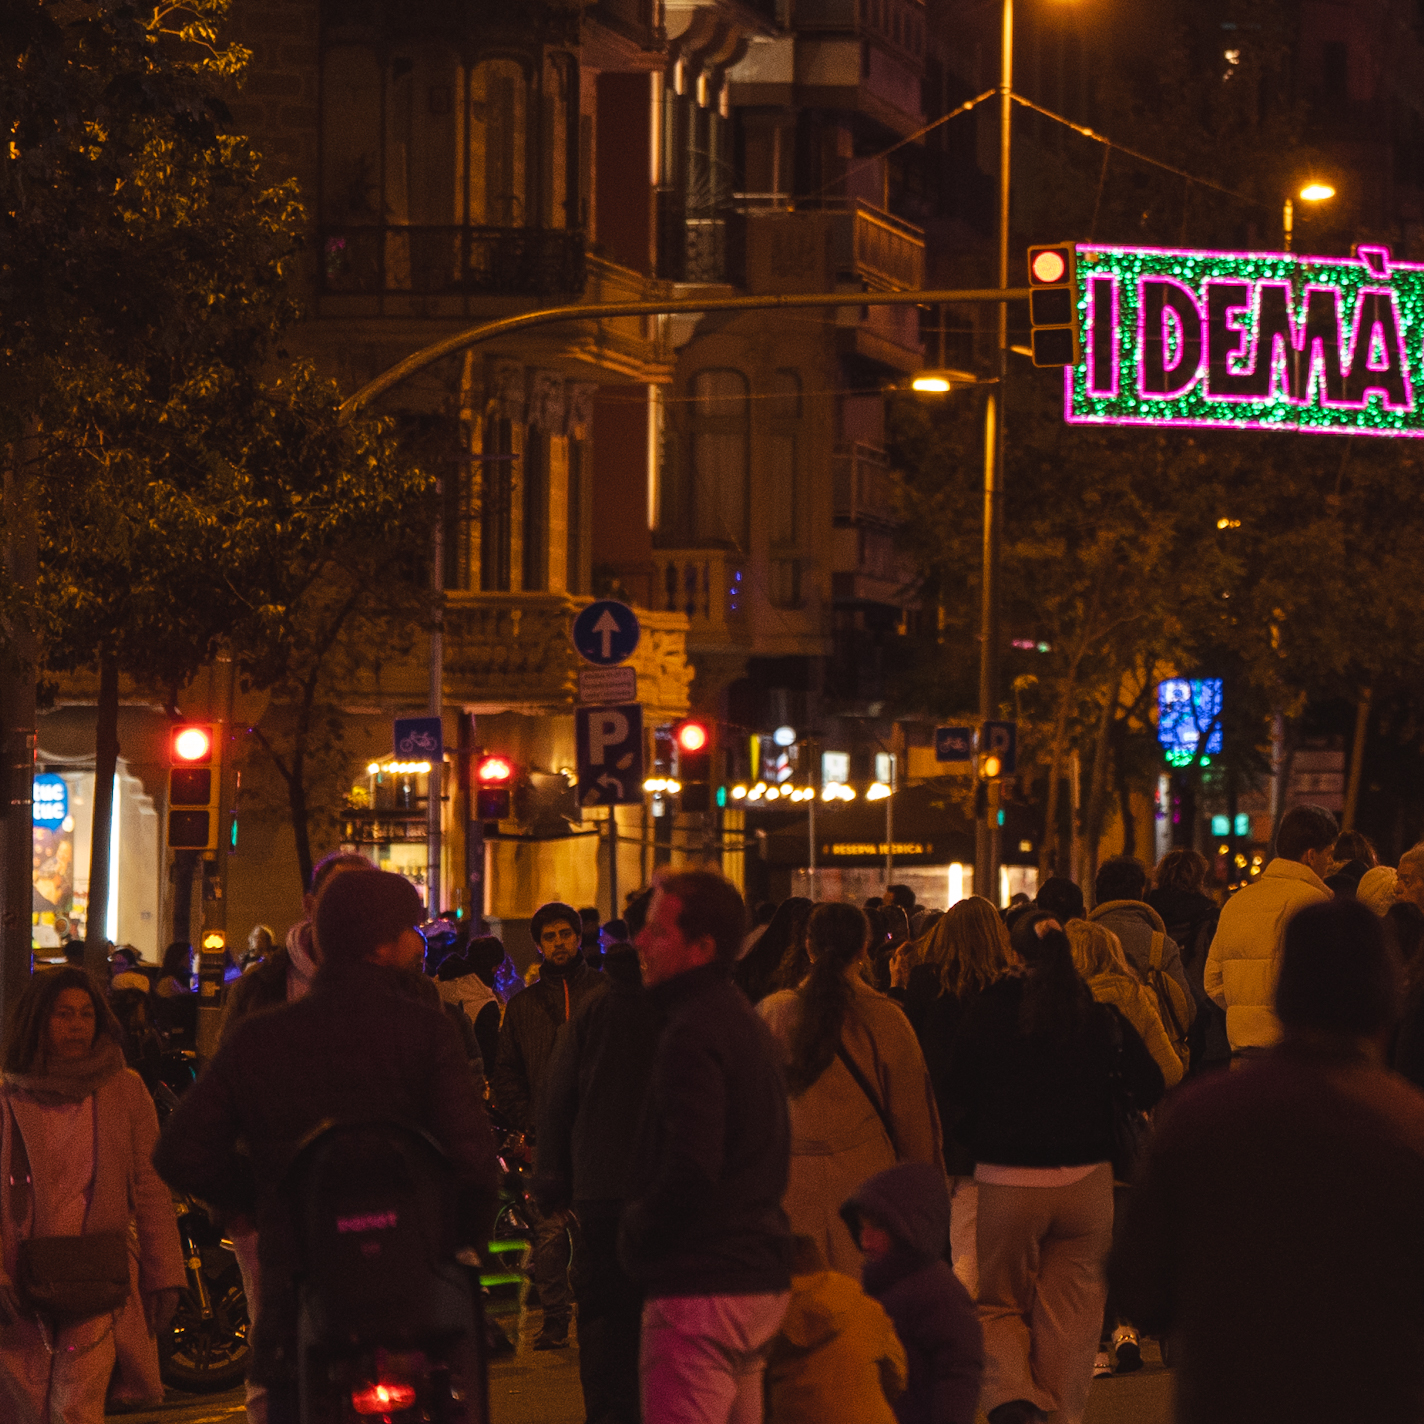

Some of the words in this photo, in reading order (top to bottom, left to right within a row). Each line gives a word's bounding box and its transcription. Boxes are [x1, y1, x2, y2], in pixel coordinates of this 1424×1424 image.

[1085, 274, 1121, 399] I
[1136, 245, 1416, 412] DEMÀ
[588, 710, 629, 765] P
